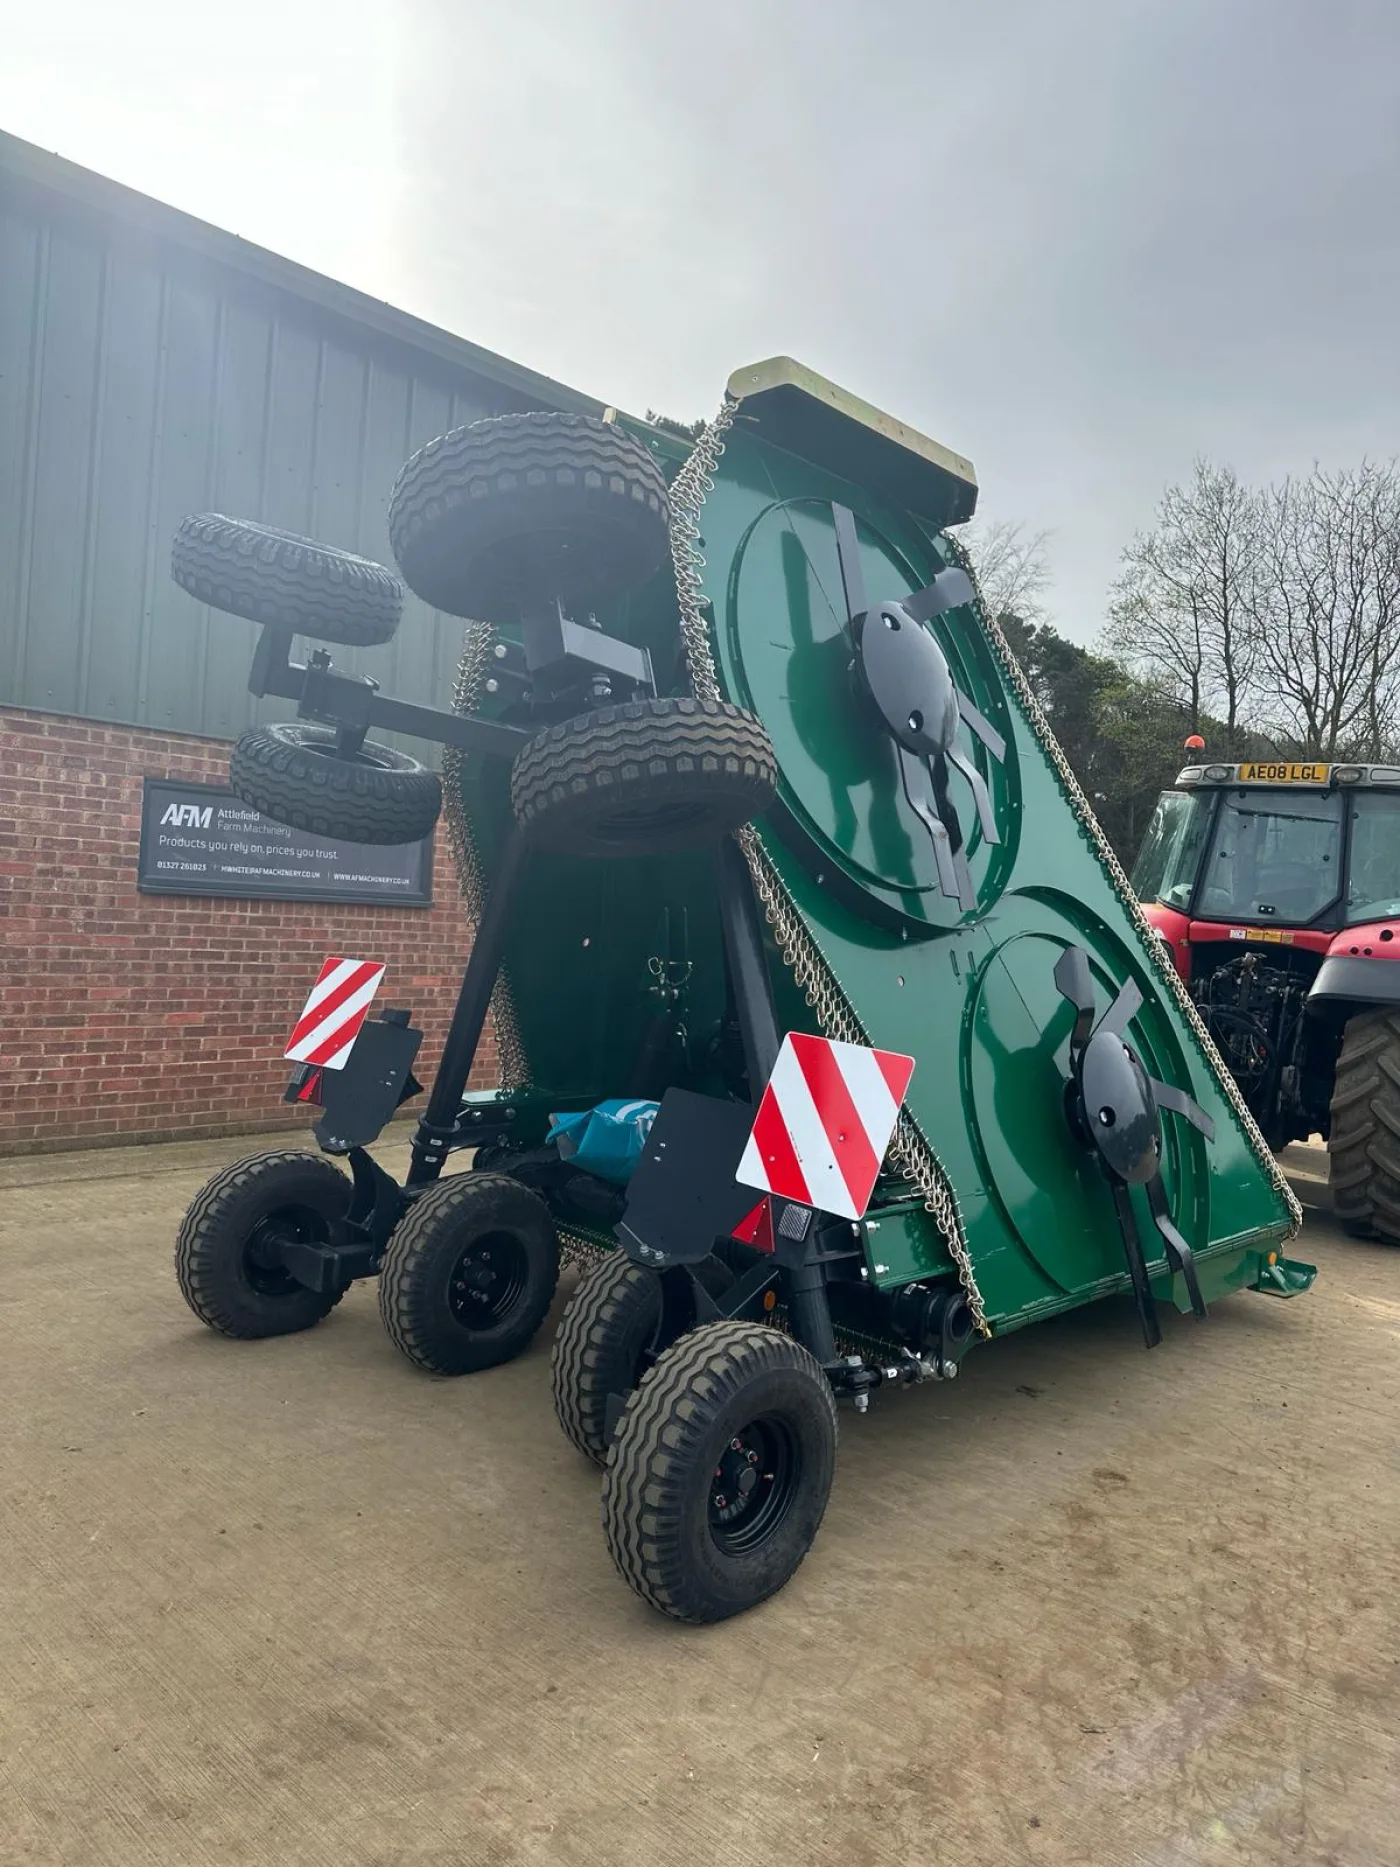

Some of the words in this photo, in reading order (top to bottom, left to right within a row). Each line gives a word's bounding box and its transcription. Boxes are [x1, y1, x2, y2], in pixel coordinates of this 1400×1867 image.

[1247, 765, 1287, 779] AE08
[1291, 765, 1321, 780] LGL
[160, 803, 213, 829] AFM
[217, 809, 260, 821] Attlefield
[217, 821, 242, 832] Farm
[243, 823, 291, 838] Machinery
[159, 835, 206, 848] Products
[208, 841, 228, 852] you
[229, 841, 248, 855] rely
[266, 844, 294, 857] prices
[296, 847, 315, 859] you
